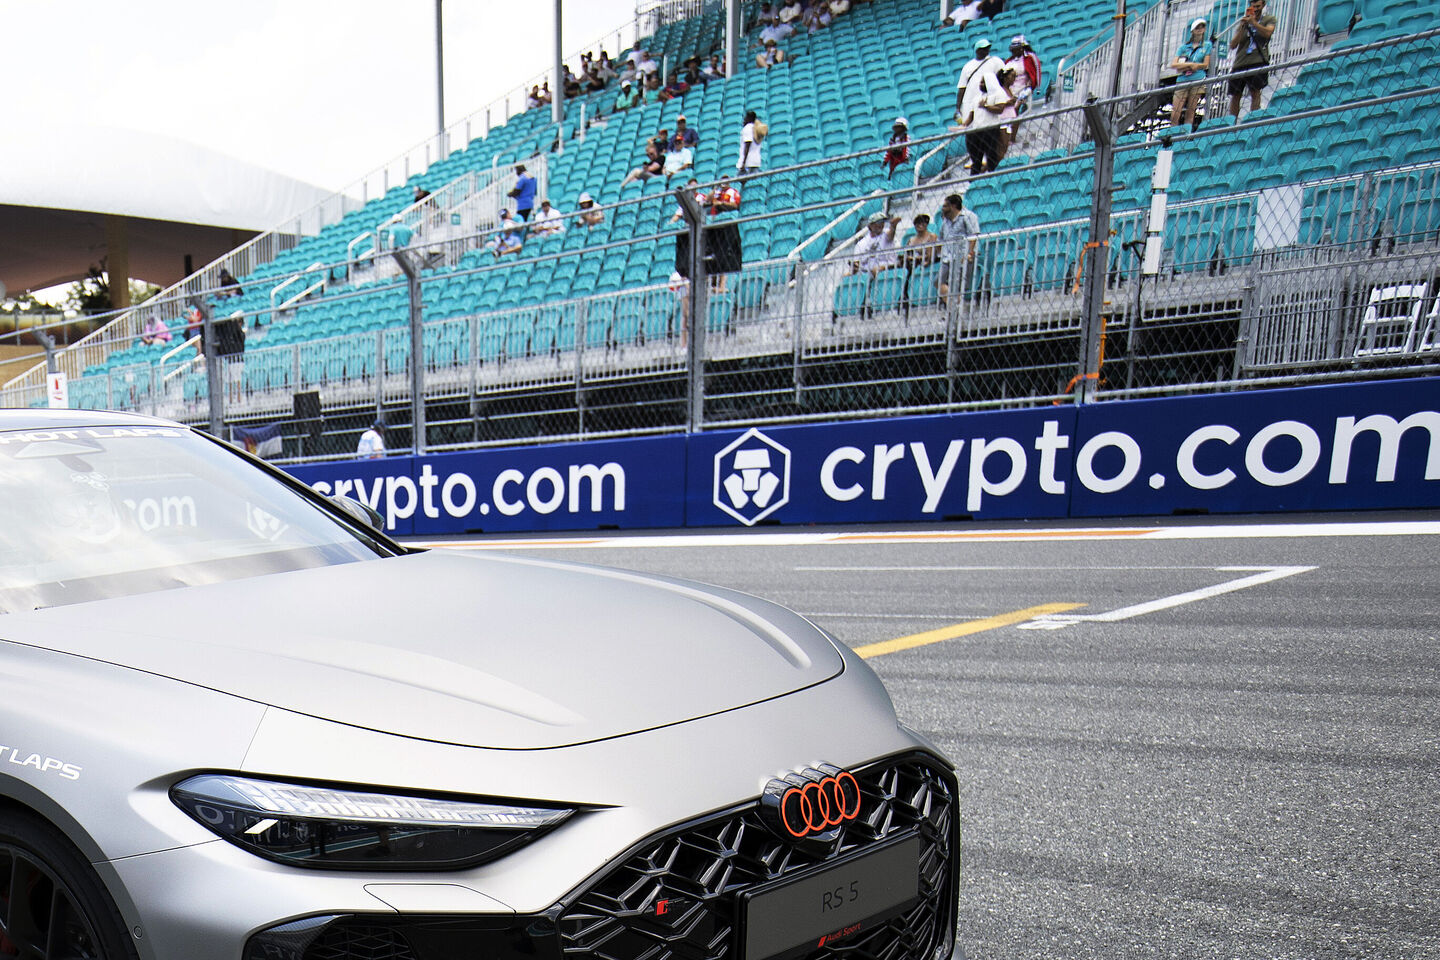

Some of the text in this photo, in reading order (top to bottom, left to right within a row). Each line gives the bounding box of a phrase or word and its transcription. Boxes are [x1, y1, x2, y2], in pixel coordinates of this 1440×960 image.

[820, 411, 1440, 513] crypto.com
[9, 749, 83, 780] LAPS
[822, 880, 858, 912] RS 5
